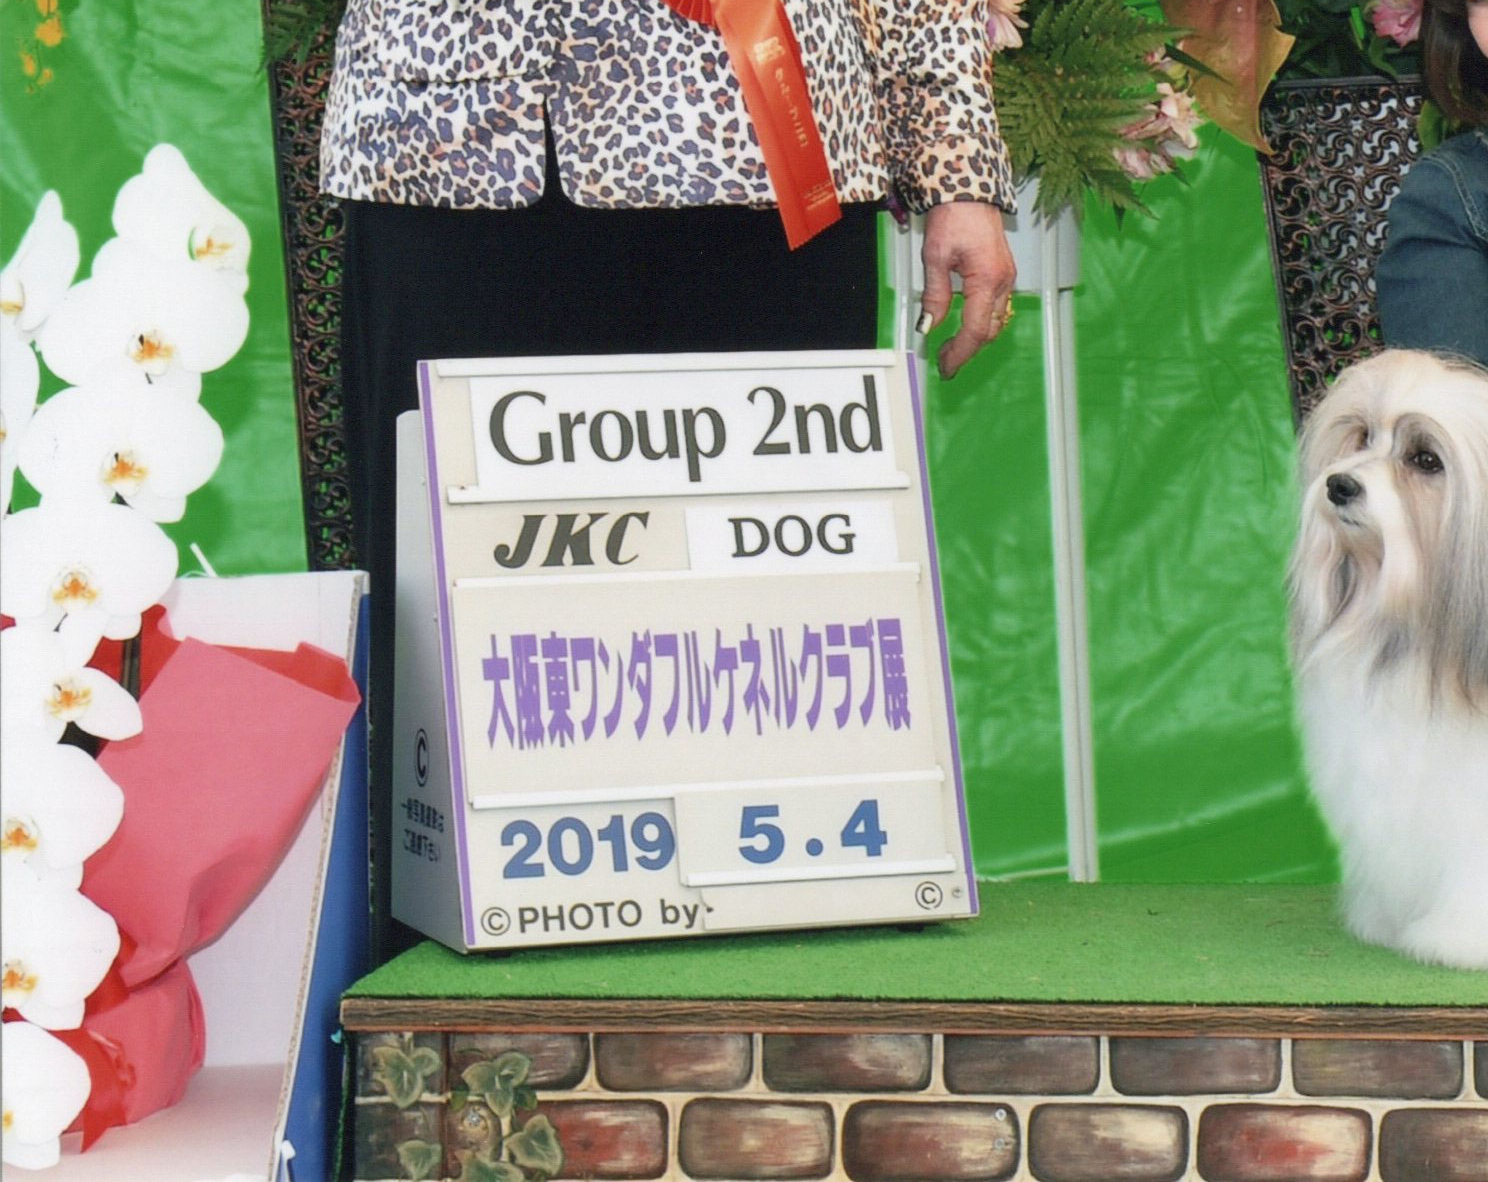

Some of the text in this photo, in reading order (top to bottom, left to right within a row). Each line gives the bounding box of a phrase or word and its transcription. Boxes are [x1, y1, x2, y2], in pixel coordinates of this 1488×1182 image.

[489, 374, 884, 482] Group 2nd
[494, 511, 651, 569] JKC
[728, 513, 857, 558] DOG
[482, 618, 911, 750] 大阪東ワンダフルケネルクラブ展
[500, 811, 675, 880] 2019
[660, 898, 699, 929] by
